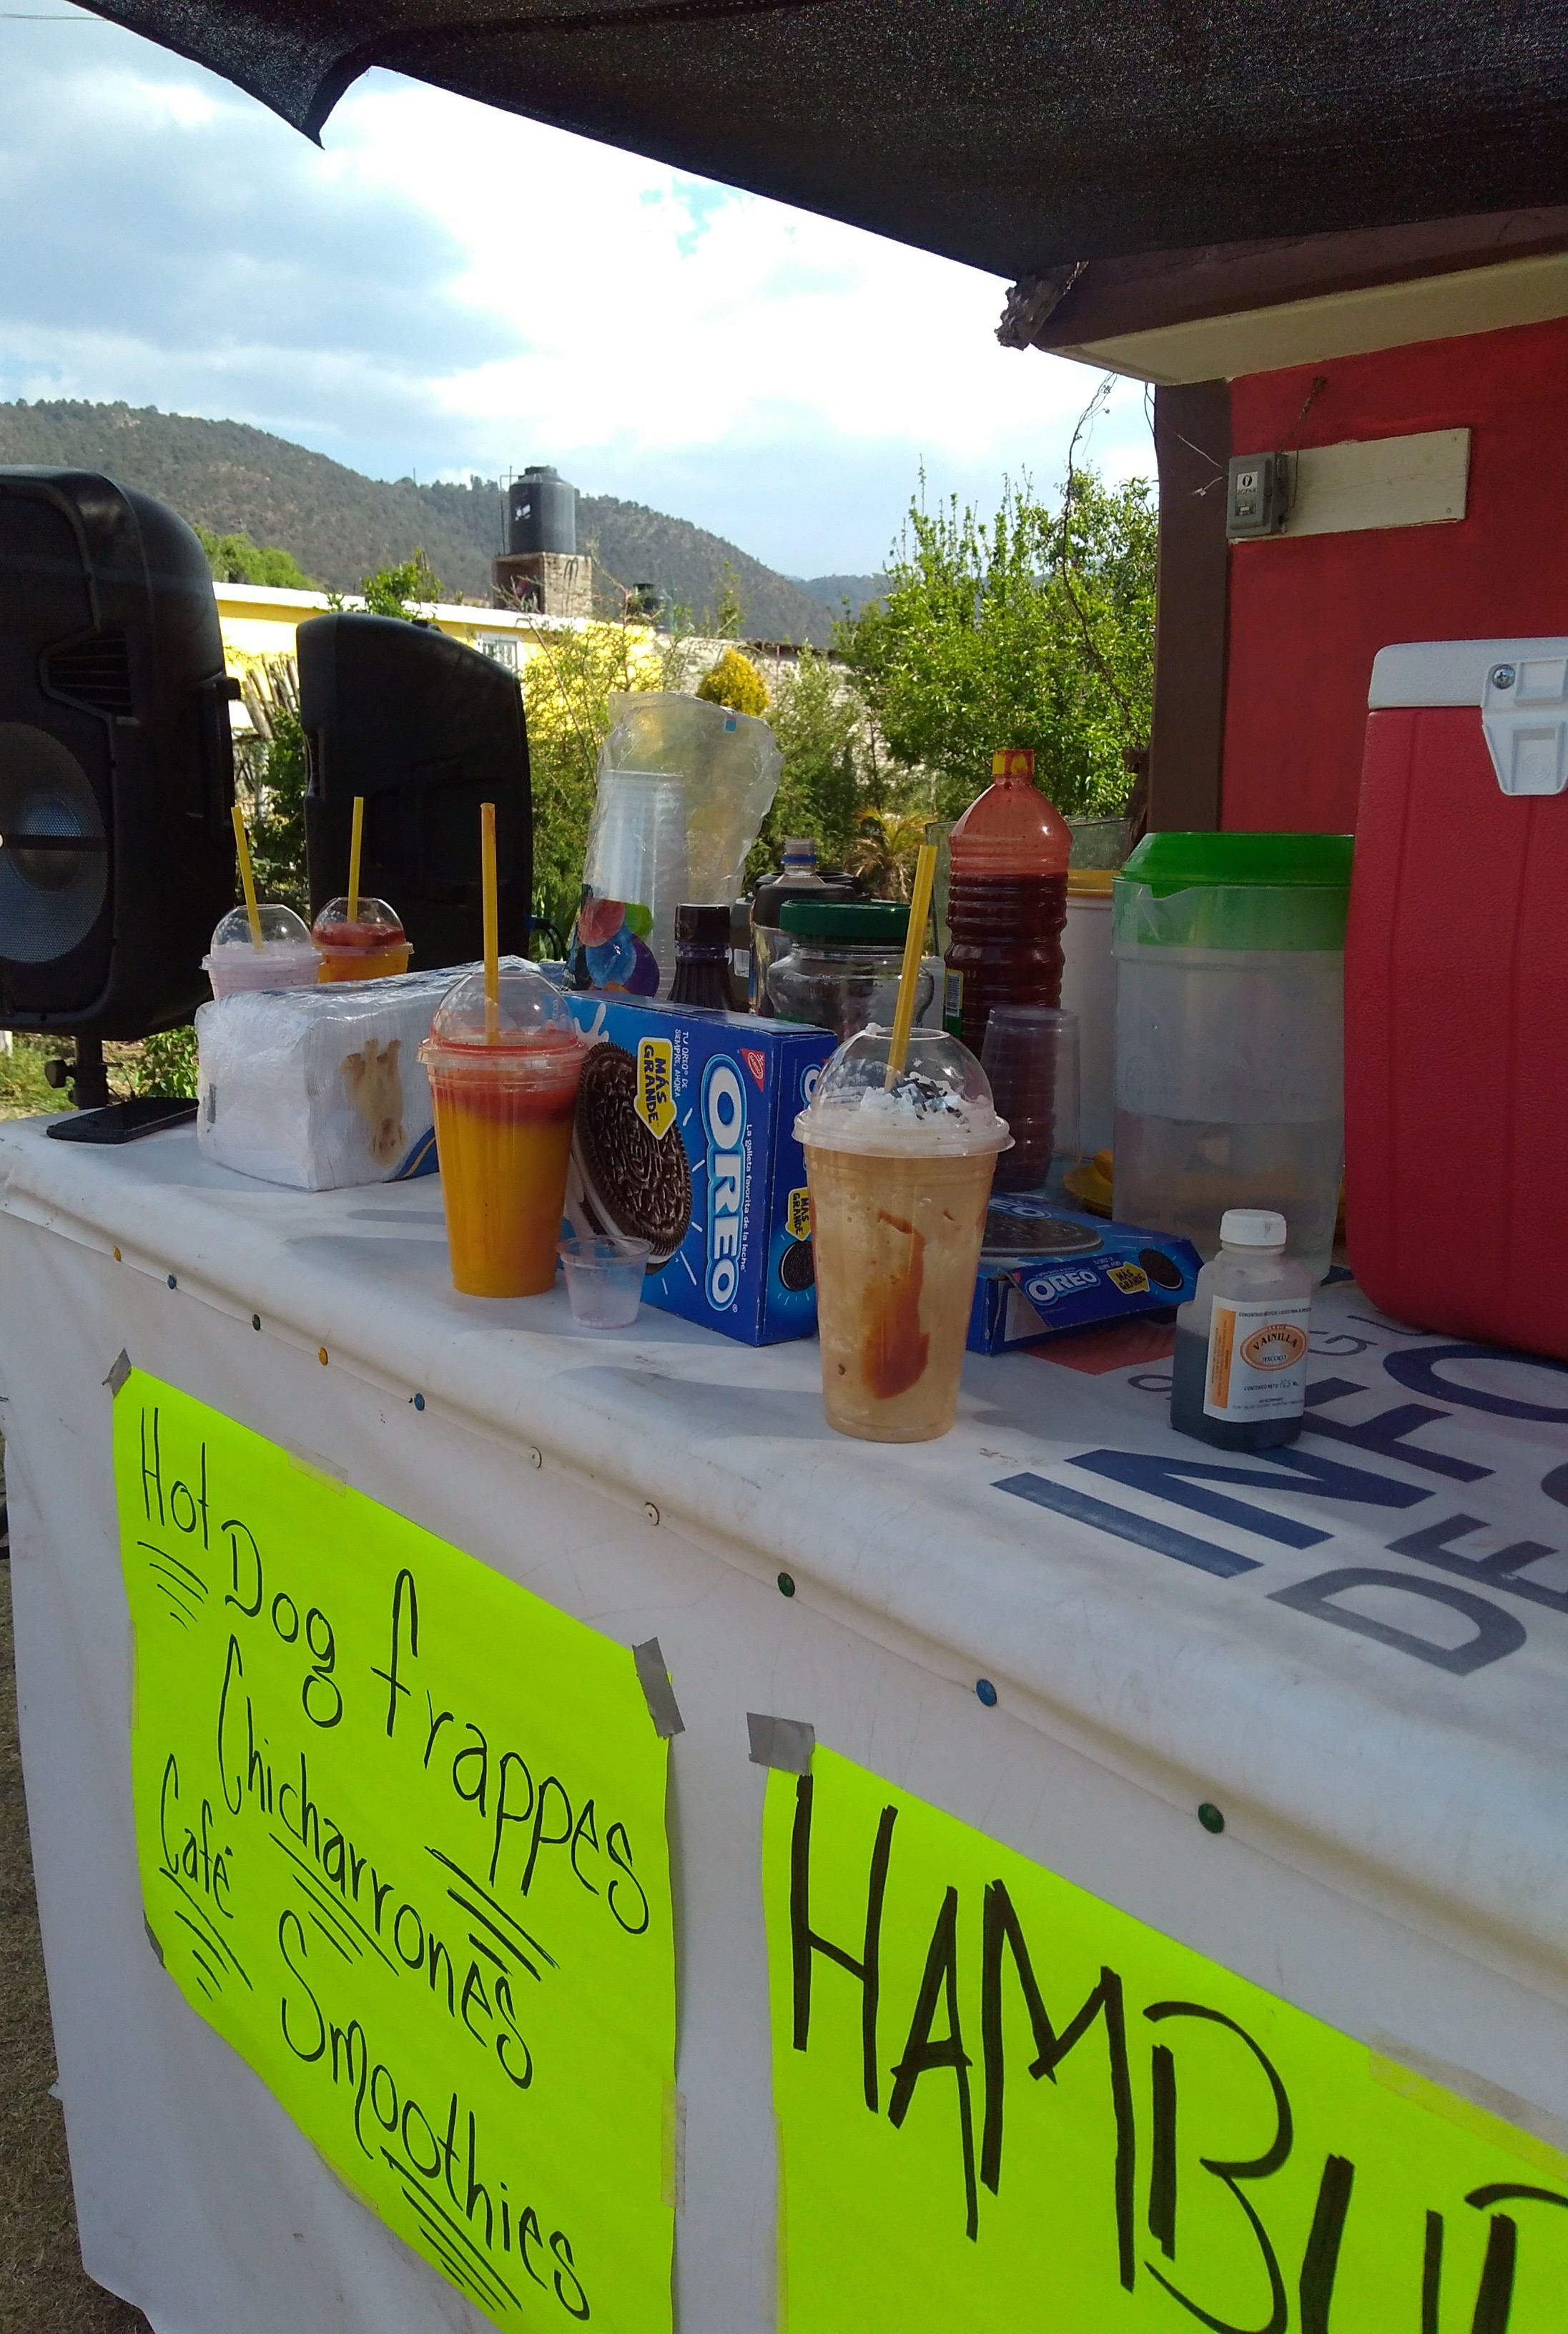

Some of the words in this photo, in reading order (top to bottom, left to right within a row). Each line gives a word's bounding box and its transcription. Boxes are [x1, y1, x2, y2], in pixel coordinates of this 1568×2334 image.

[681, 1031, 689, 1045] TU
[643, 1045, 659, 1124] GRANDE
[654, 1057, 670, 1104] MÁS
[681, 1078, 689, 1089] DE
[746, 1124, 753, 1136] La
[706, 1063, 745, 1305] OREO
[743, 1175, 752, 1213] favorita
[792, 1193, 804, 1235] GRANDE
[988, 1198, 1045, 1217] EO
[741, 1231, 749, 1241] la
[743, 1216, 750, 1229] de
[740, 1243, 749, 1270] leche
[1027, 1269, 1098, 1302] OREO
[1116, 1269, 1135, 1282] MÁS
[1118, 1274, 1147, 1290] GRANDE
[1253, 1332, 1298, 1351] VAINILLA
[139, 1406, 209, 1550] Hot
[221, 1520, 344, 1728] Dog
[370, 1568, 649, 1934] frappes
[217, 1633, 533, 2089] Chicharrones
[277, 1909, 591, 2322] Smoothies
